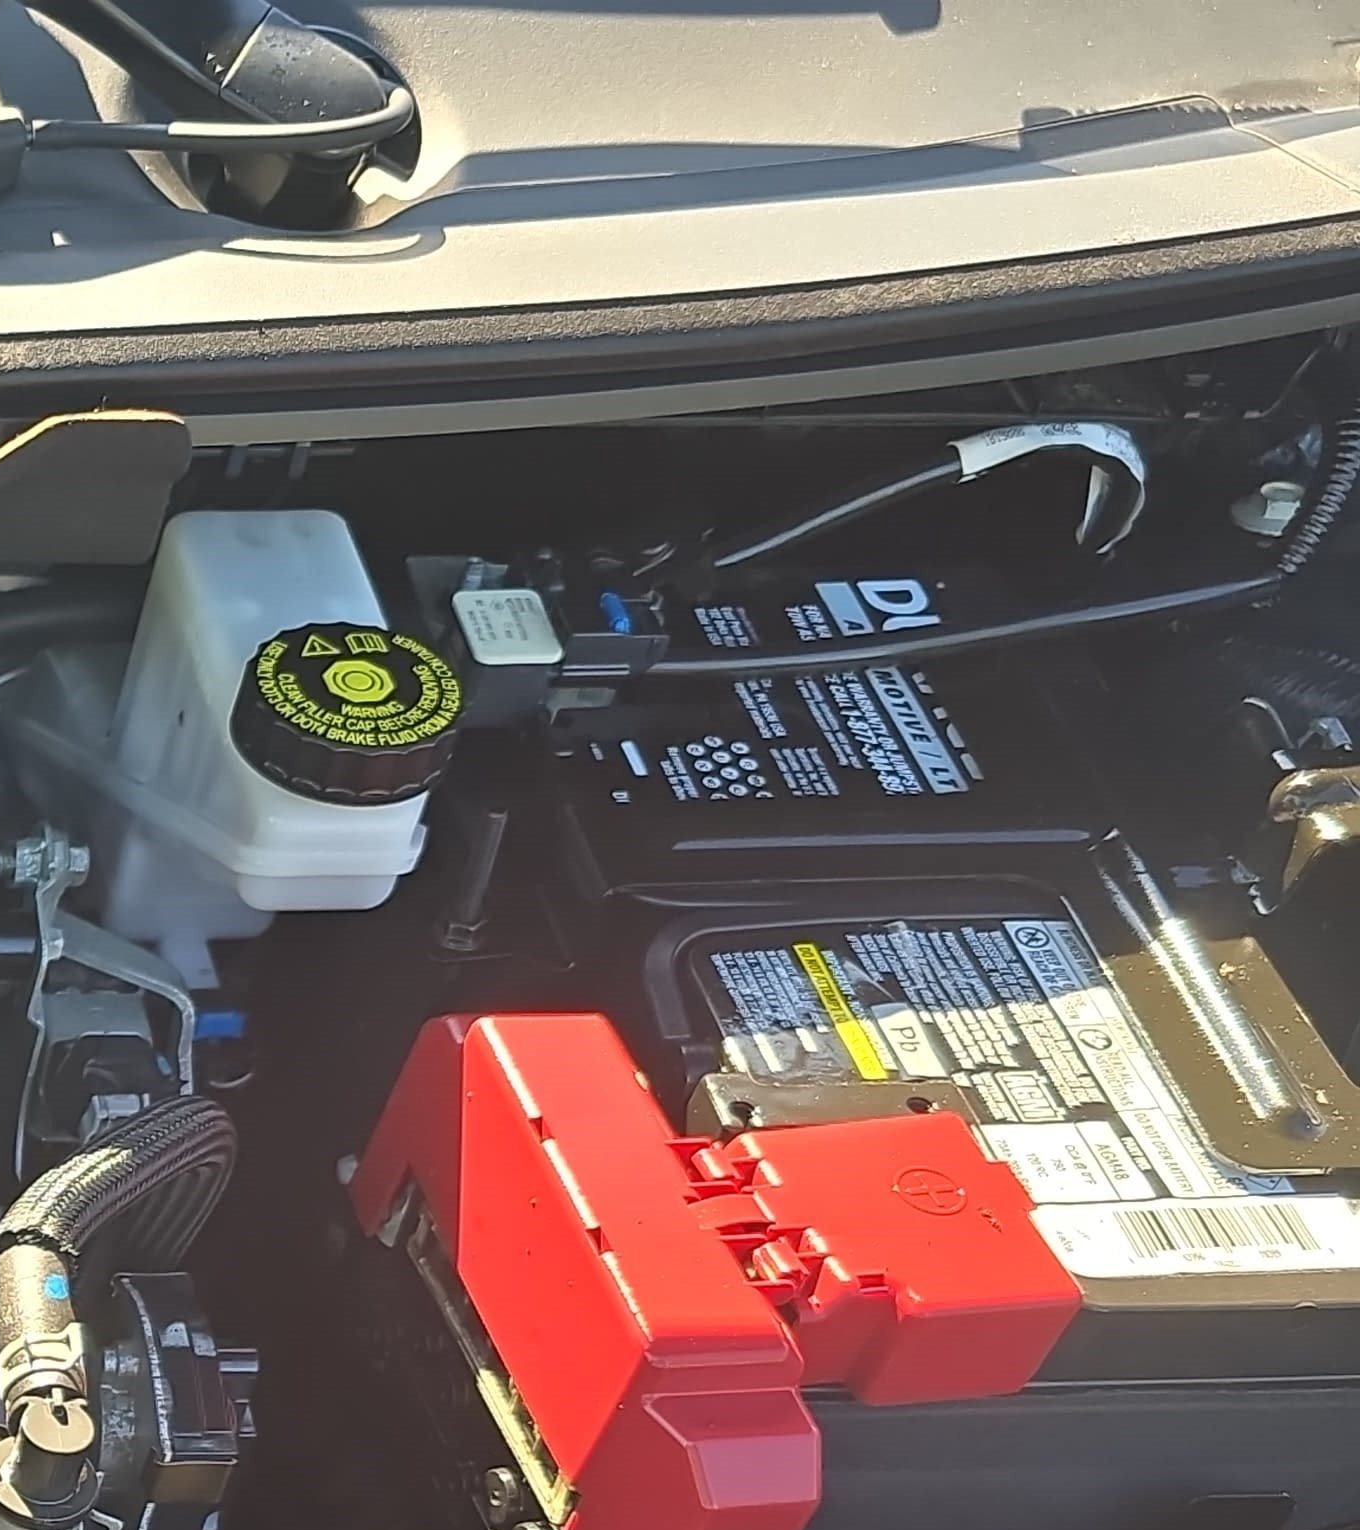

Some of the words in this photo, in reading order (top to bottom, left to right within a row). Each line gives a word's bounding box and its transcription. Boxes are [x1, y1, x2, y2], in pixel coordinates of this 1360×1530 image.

[391, 634, 453, 677] CONTAINER
[277, 673, 306, 704] CLEAN
[302, 701, 345, 726] FILLER
[345, 718, 376, 732] CAP
[378, 705, 429, 732] BEFORE
[440, 678, 460, 712] SEALED
[275, 702, 297, 718] OR
[340, 701, 404, 719] WARNING
[291, 712, 326, 736] DOT4
[413, 714, 449, 738] FROM
[327, 729, 378, 746] BRAKE
[379, 729, 419, 746] FLUID
[837, 709, 907, 795] 1-877-344-89
[797, 946, 814, 957] DO
[1040, 948, 1064, 966] KEEP
[803, 958, 825, 975] NOT
[1051, 966, 1073, 982] OUT
[812, 975, 845, 1011] ATTEMPT
[831, 1013, 850, 1023] TO
[888, 1026, 925, 1052] Pb
[1001, 1076, 1056, 1118] AGM
[1132, 1112, 1151, 1123] DO
[1140, 1124, 1161, 1138] NOT
[1150, 1140, 1176, 1160] OPEN
[1093, 1143, 1132, 1180] AGM48
[1164, 1162, 1195, 1193] BATTERY
